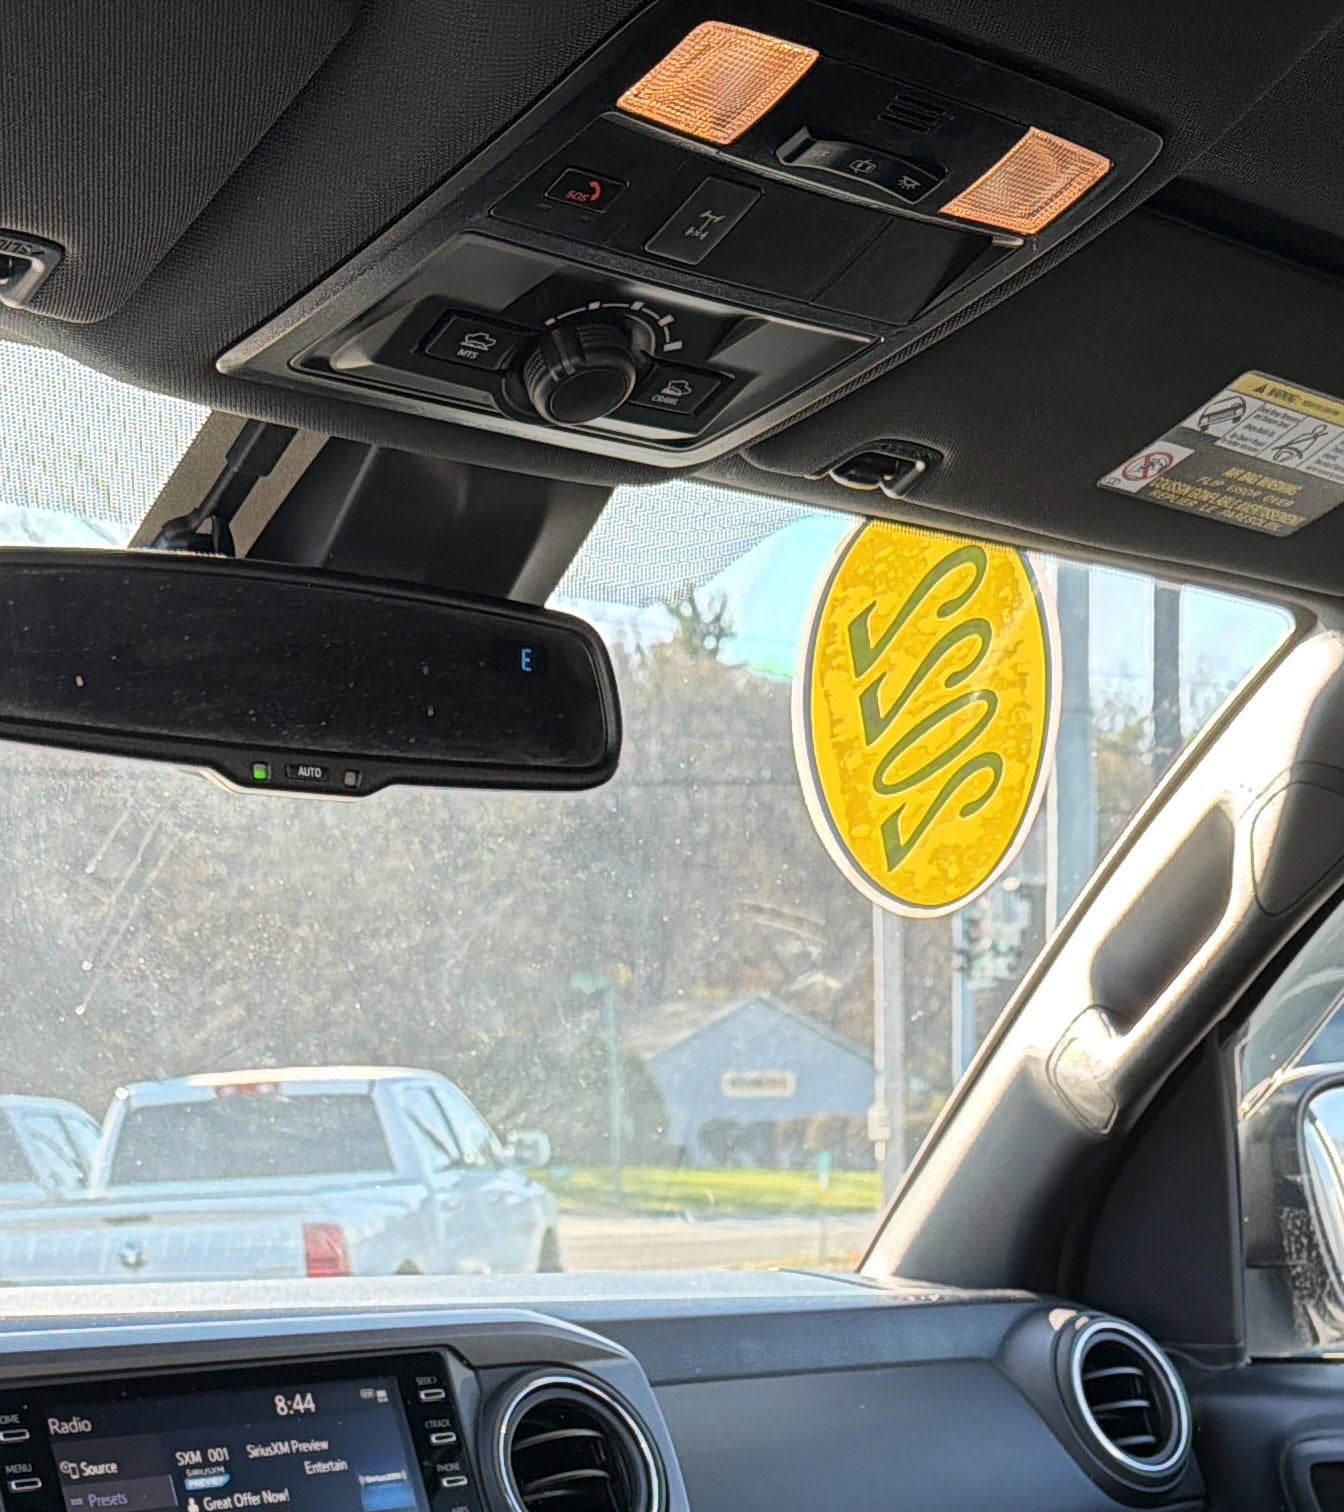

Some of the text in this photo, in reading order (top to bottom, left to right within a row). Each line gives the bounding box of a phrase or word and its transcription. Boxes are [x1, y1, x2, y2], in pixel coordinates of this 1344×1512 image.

[565, 189, 590, 202] SOS
[457, 349, 479, 360] MTS
[520, 648, 533, 672] E
[297, 765, 322, 779] AUTO
[273, 1391, 317, 1418] 8:44
[47, 1416, 92, 1436] Radio
[175, 1447, 230, 1467] SXM 001
[246, 1438, 329, 1460] SiriusXM Preview
[6, 1463, 33, 1475] MENU
[80, 1461, 119, 1477] Source
[304, 1458, 349, 1476] Entertain
[88, 1492, 129, 1508] Presets
[203, 1488, 290, 1512] Great Offer Now!
